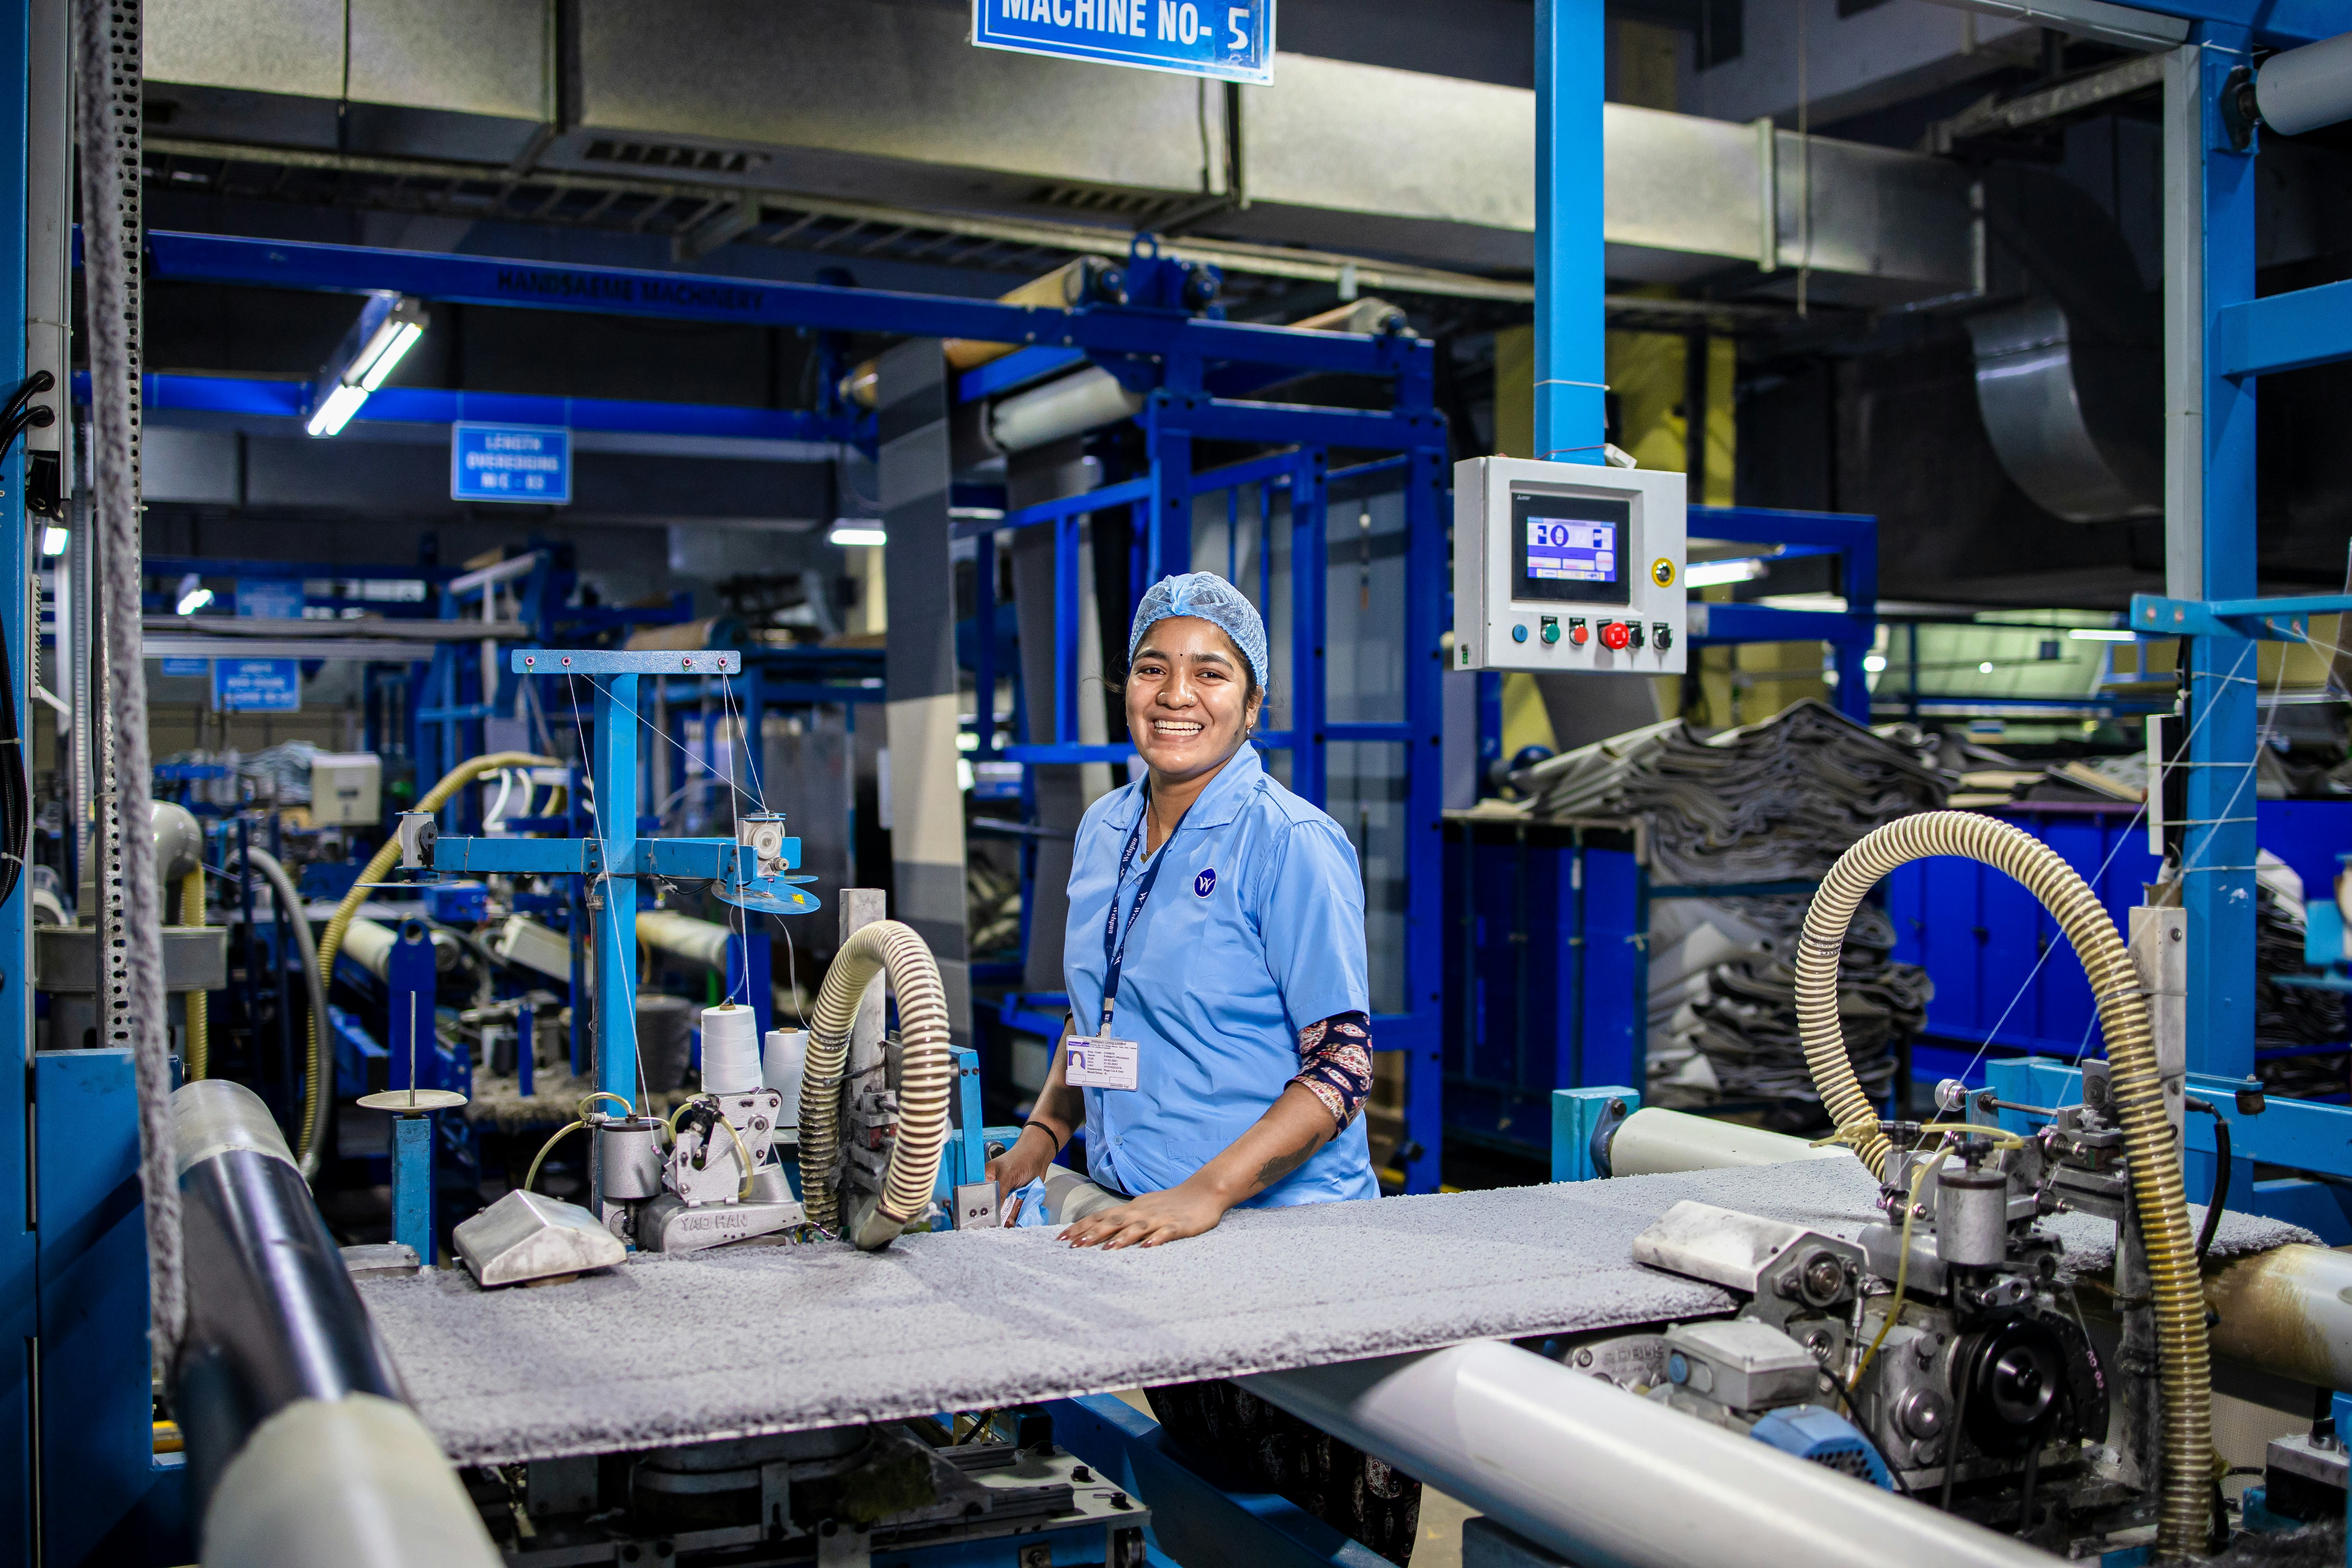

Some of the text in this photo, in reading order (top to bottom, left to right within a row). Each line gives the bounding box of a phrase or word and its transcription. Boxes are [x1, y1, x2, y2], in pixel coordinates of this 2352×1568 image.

[1158, 0, 1212, 45] NO-
[1227, 7, 1250, 49] 5
[1123, 837, 1138, 862] Welspun
[1108, 907, 1118, 934] Welspun
[681, 1214, 748, 1232] YAO HAN
